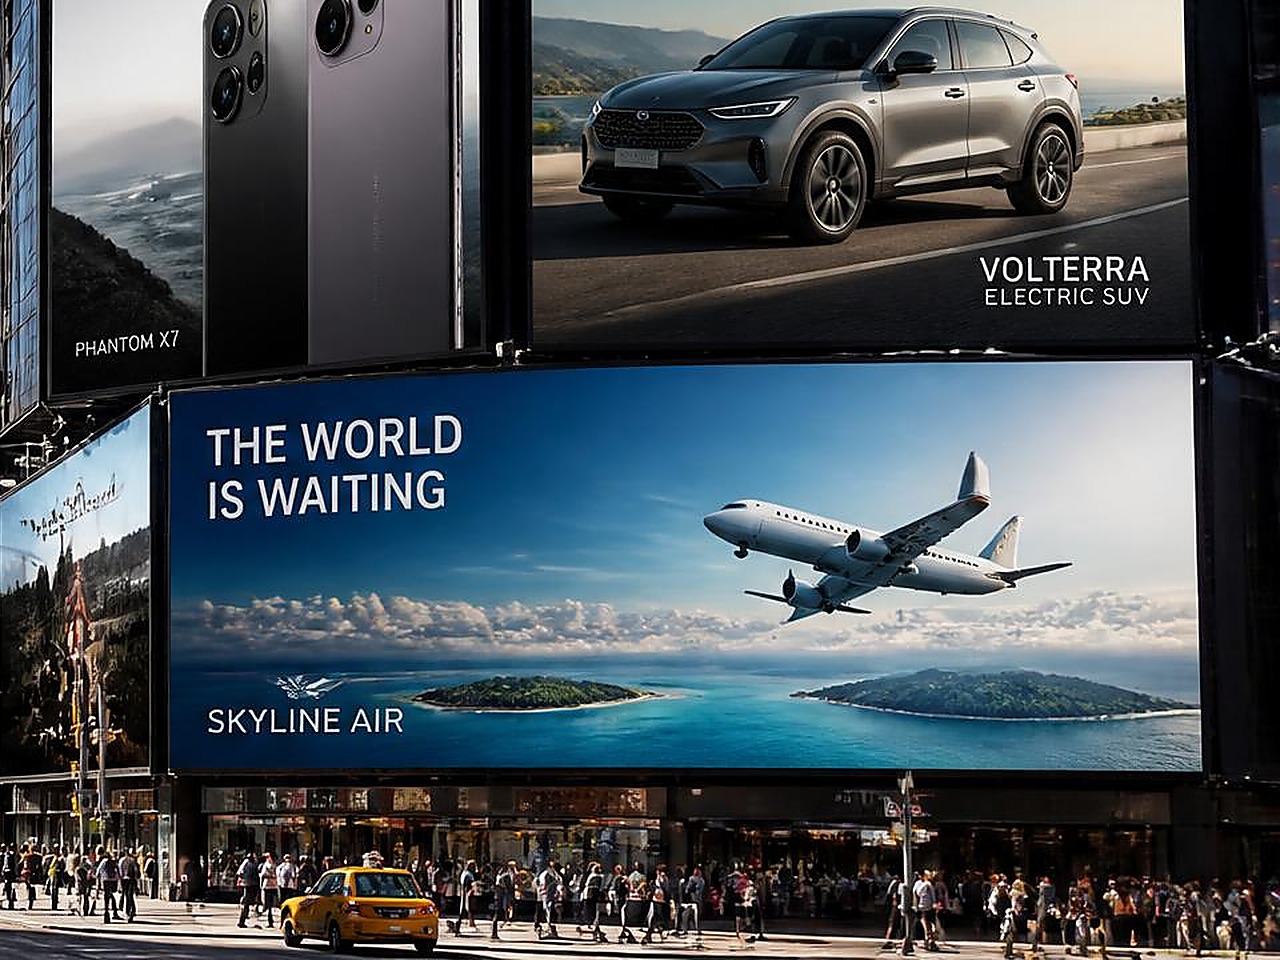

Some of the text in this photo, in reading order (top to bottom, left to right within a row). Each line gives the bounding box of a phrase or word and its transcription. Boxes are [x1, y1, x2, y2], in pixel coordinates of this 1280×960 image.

[979, 256, 1150, 283] VOLTERRA
[985, 287, 1150, 306] ELECTRIC SUV
[75, 329, 180, 358] PHANTOM X7
[206, 414, 463, 467] THE WORLD
[208, 470, 445, 520] IS WAITING
[207, 707, 404, 735] SKYLINE AIR
